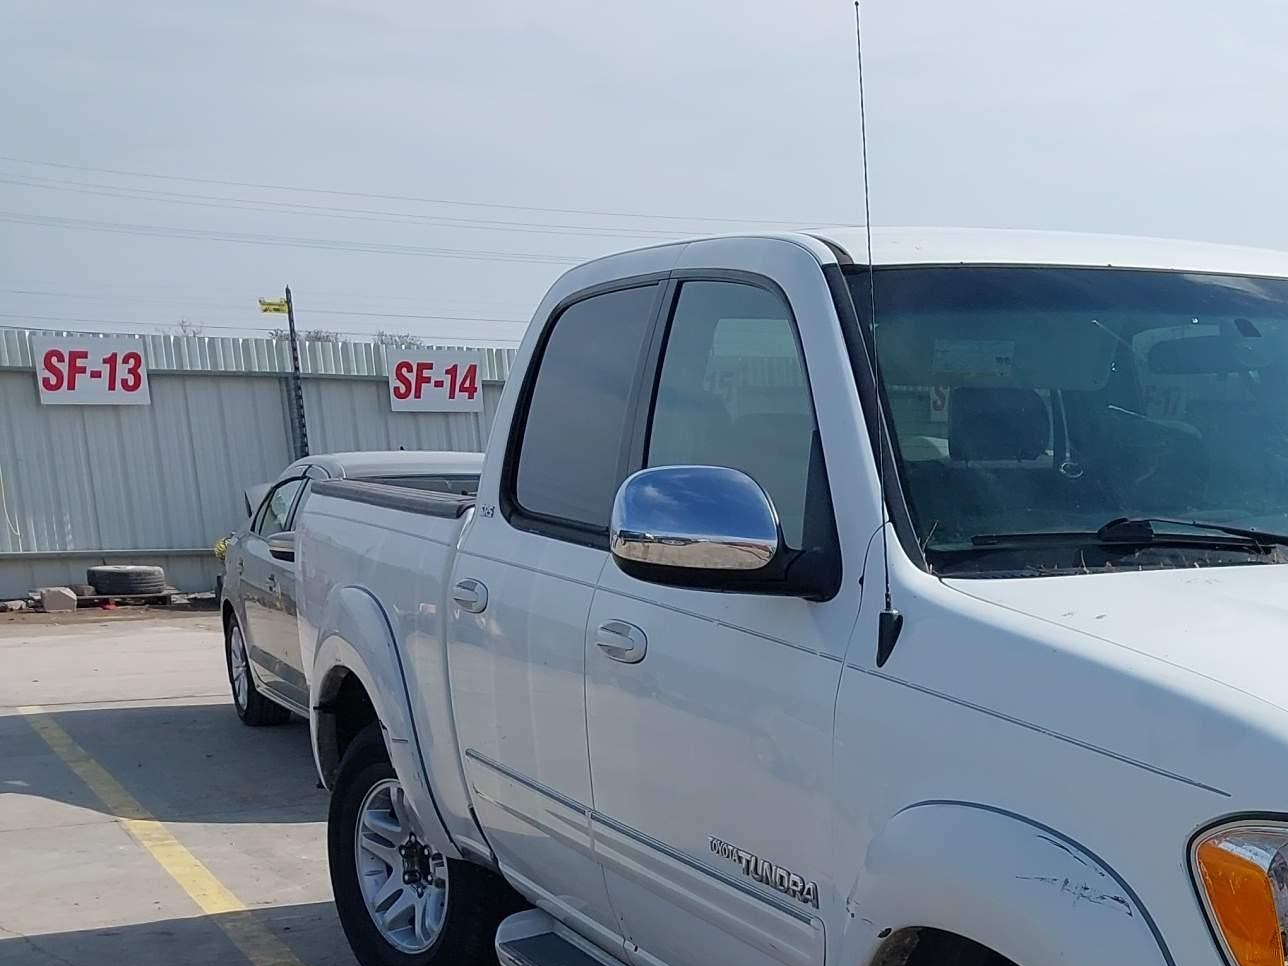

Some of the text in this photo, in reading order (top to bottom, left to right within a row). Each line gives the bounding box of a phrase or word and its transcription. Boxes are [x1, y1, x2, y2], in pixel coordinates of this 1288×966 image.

[42, 349, 142, 392] SF-13
[393, 361, 478, 400] SF-14
[708, 837, 820, 910] TOYOTA TUNDRA
